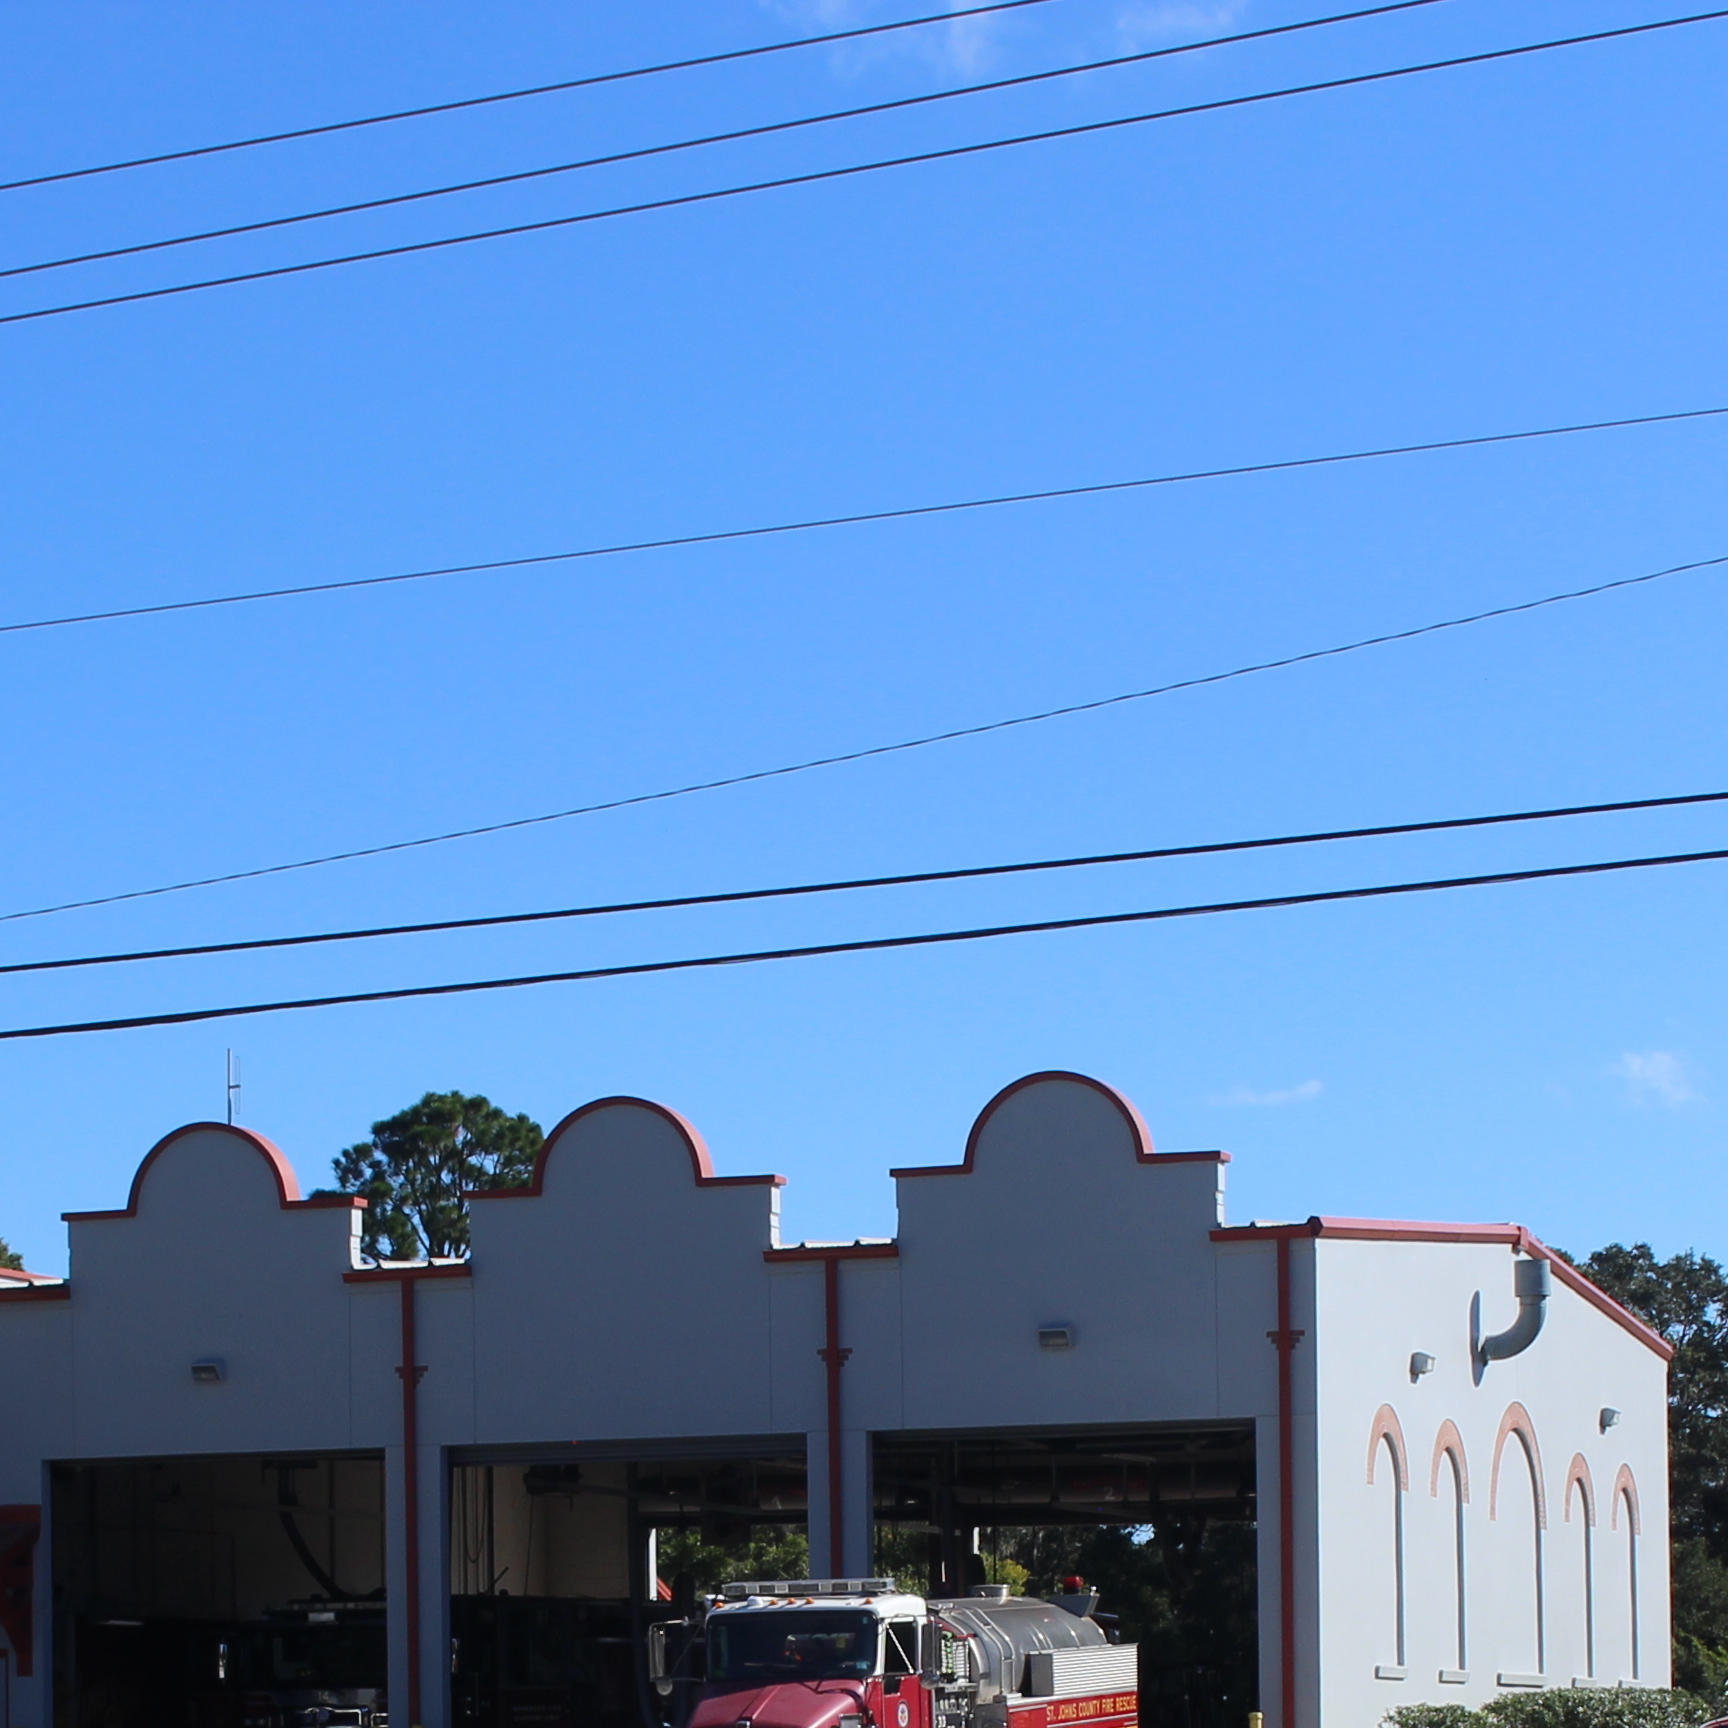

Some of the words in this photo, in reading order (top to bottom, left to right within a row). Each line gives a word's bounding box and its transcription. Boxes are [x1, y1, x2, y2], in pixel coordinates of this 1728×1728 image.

[1046, 1705, 1056, 1721] ST.
[1058, 1703, 1077, 1720] JOHNS
[1078, 1700, 1101, 1717] COUNTY
[1102, 1698, 1115, 1713] FIRE
[1116, 1695, 1137, 1711] RESCUE
